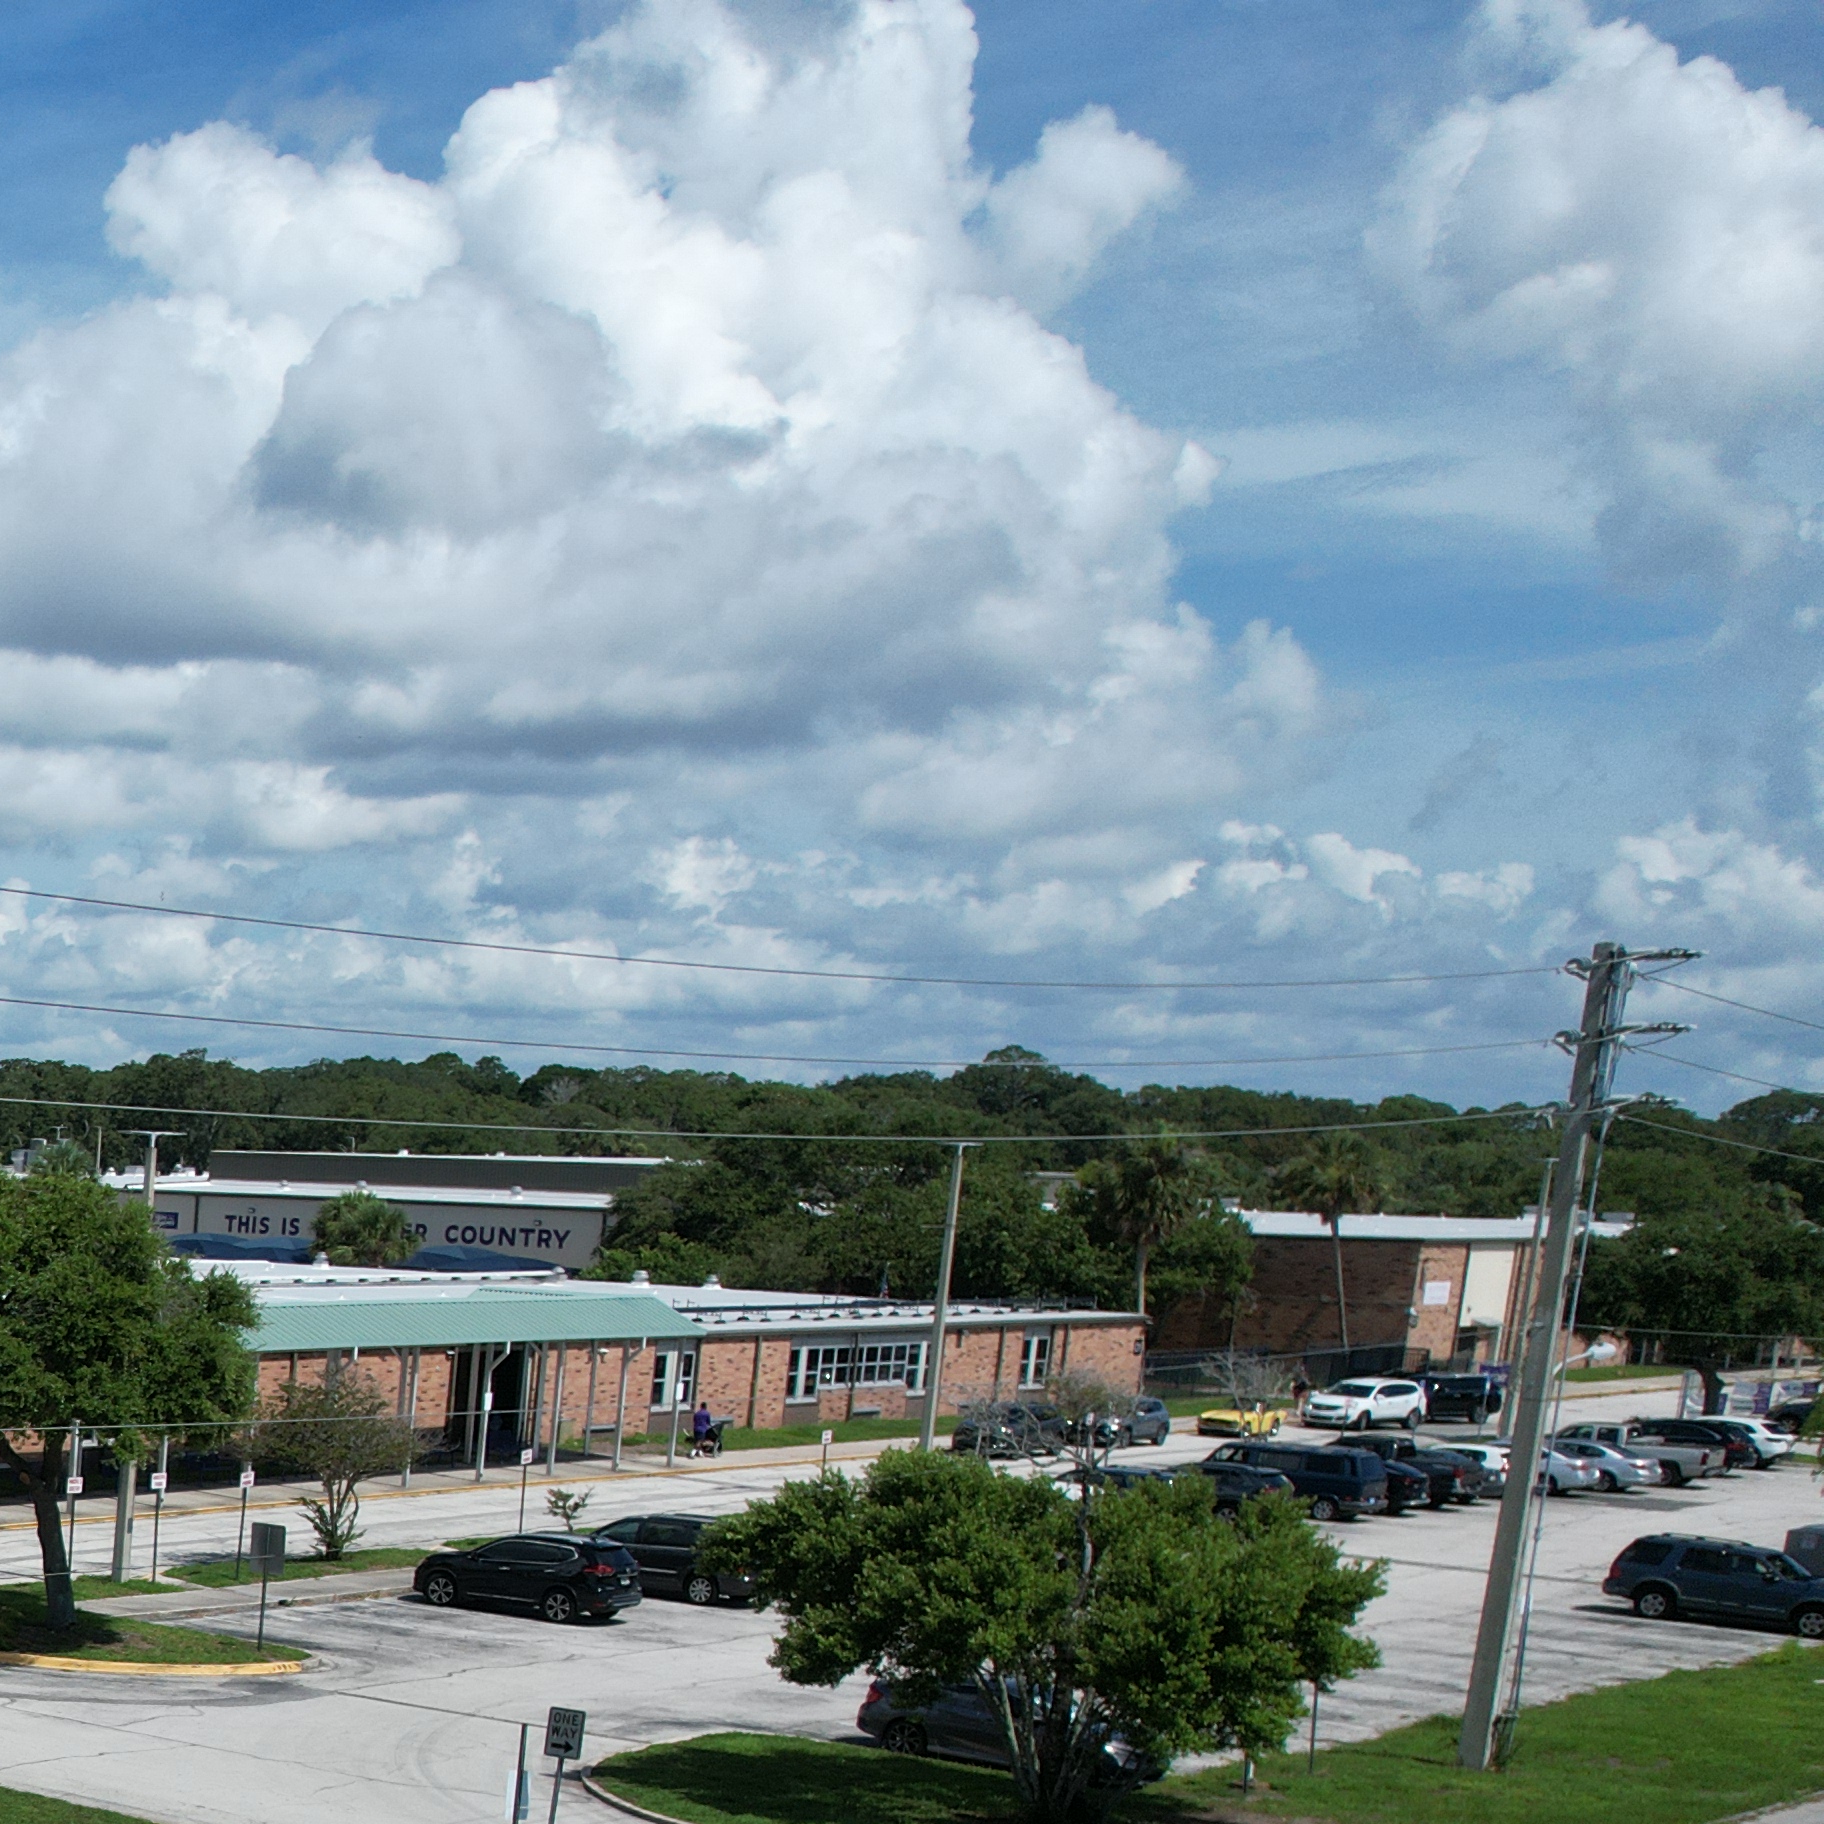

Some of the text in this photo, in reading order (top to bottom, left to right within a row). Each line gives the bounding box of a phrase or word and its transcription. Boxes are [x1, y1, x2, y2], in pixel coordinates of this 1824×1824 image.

[224, 1214, 270, 1235] THIS
[281, 1217, 300, 1236] IS
[444, 1224, 571, 1250] COUNTRY
[553, 1712, 579, 1726] ONE
[552, 1726, 578, 1739] WAY
